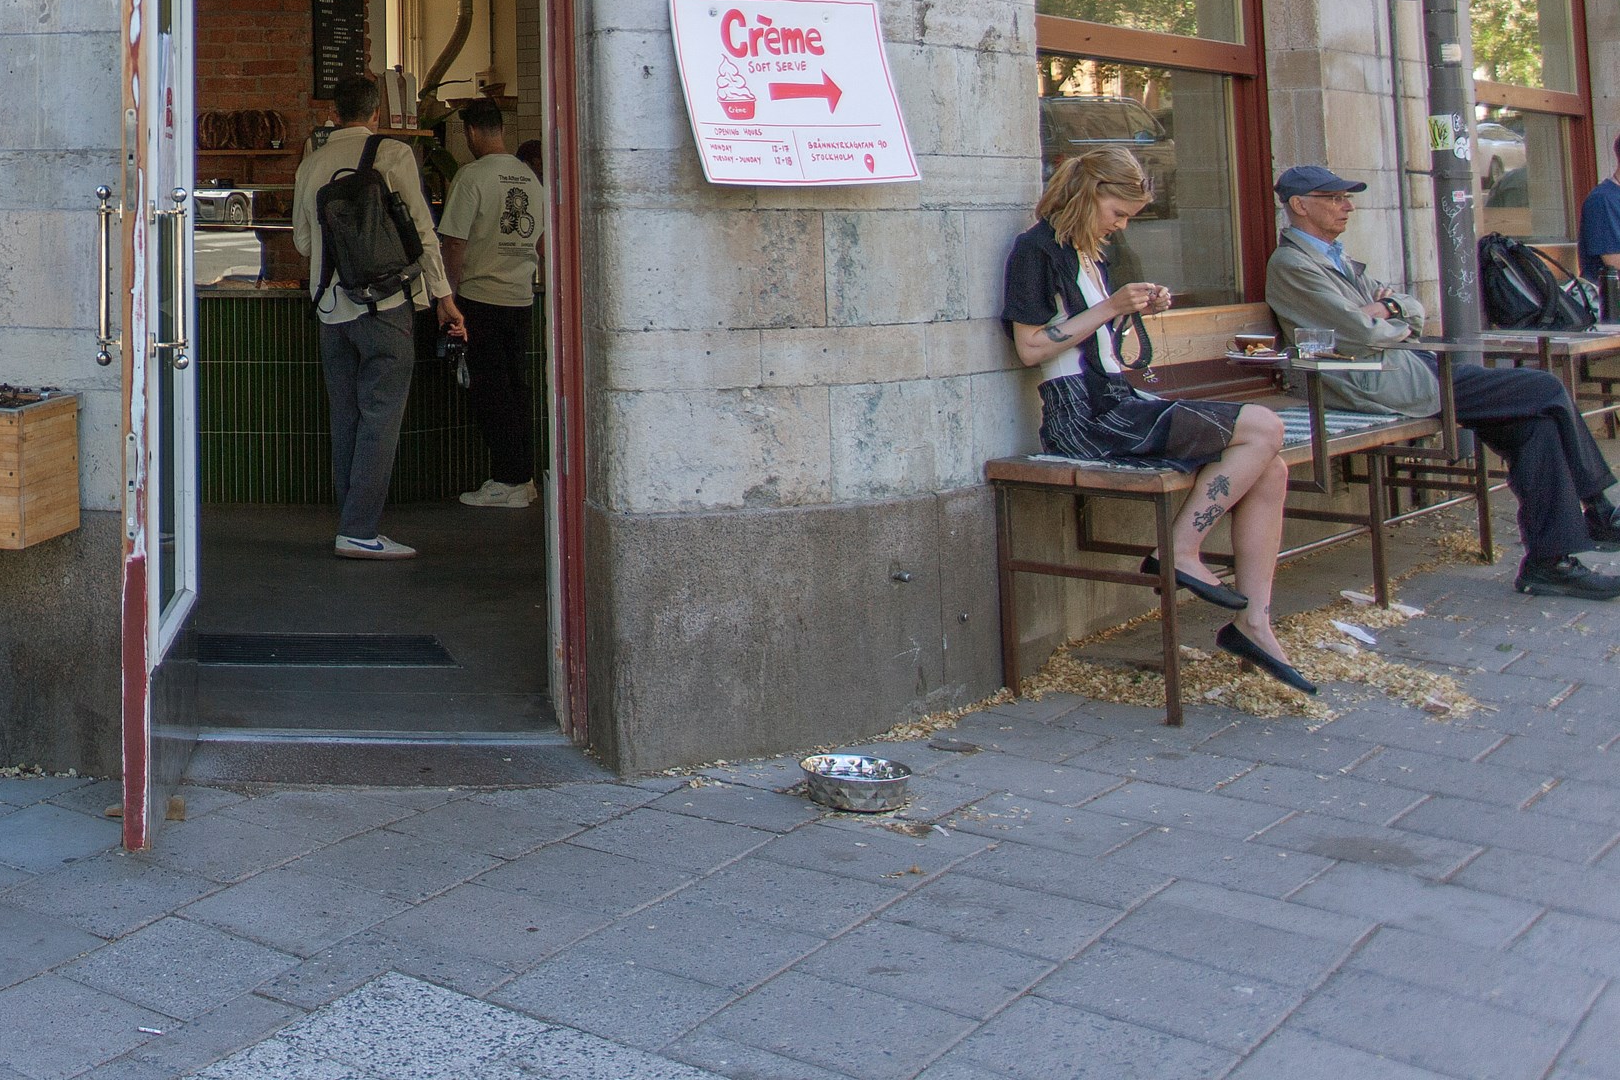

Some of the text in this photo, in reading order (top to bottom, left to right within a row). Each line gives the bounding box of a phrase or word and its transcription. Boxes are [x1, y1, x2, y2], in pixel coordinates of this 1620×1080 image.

[720, 8, 825, 59] Crème
[748, 60, 807, 74] SOFT SERVE
[714, 127, 763, 137] OPENING HOURS
[710, 143, 733, 153] MONDAY
[877, 139, 888, 150] 90
[811, 153, 855, 162] STOCKHOLM
